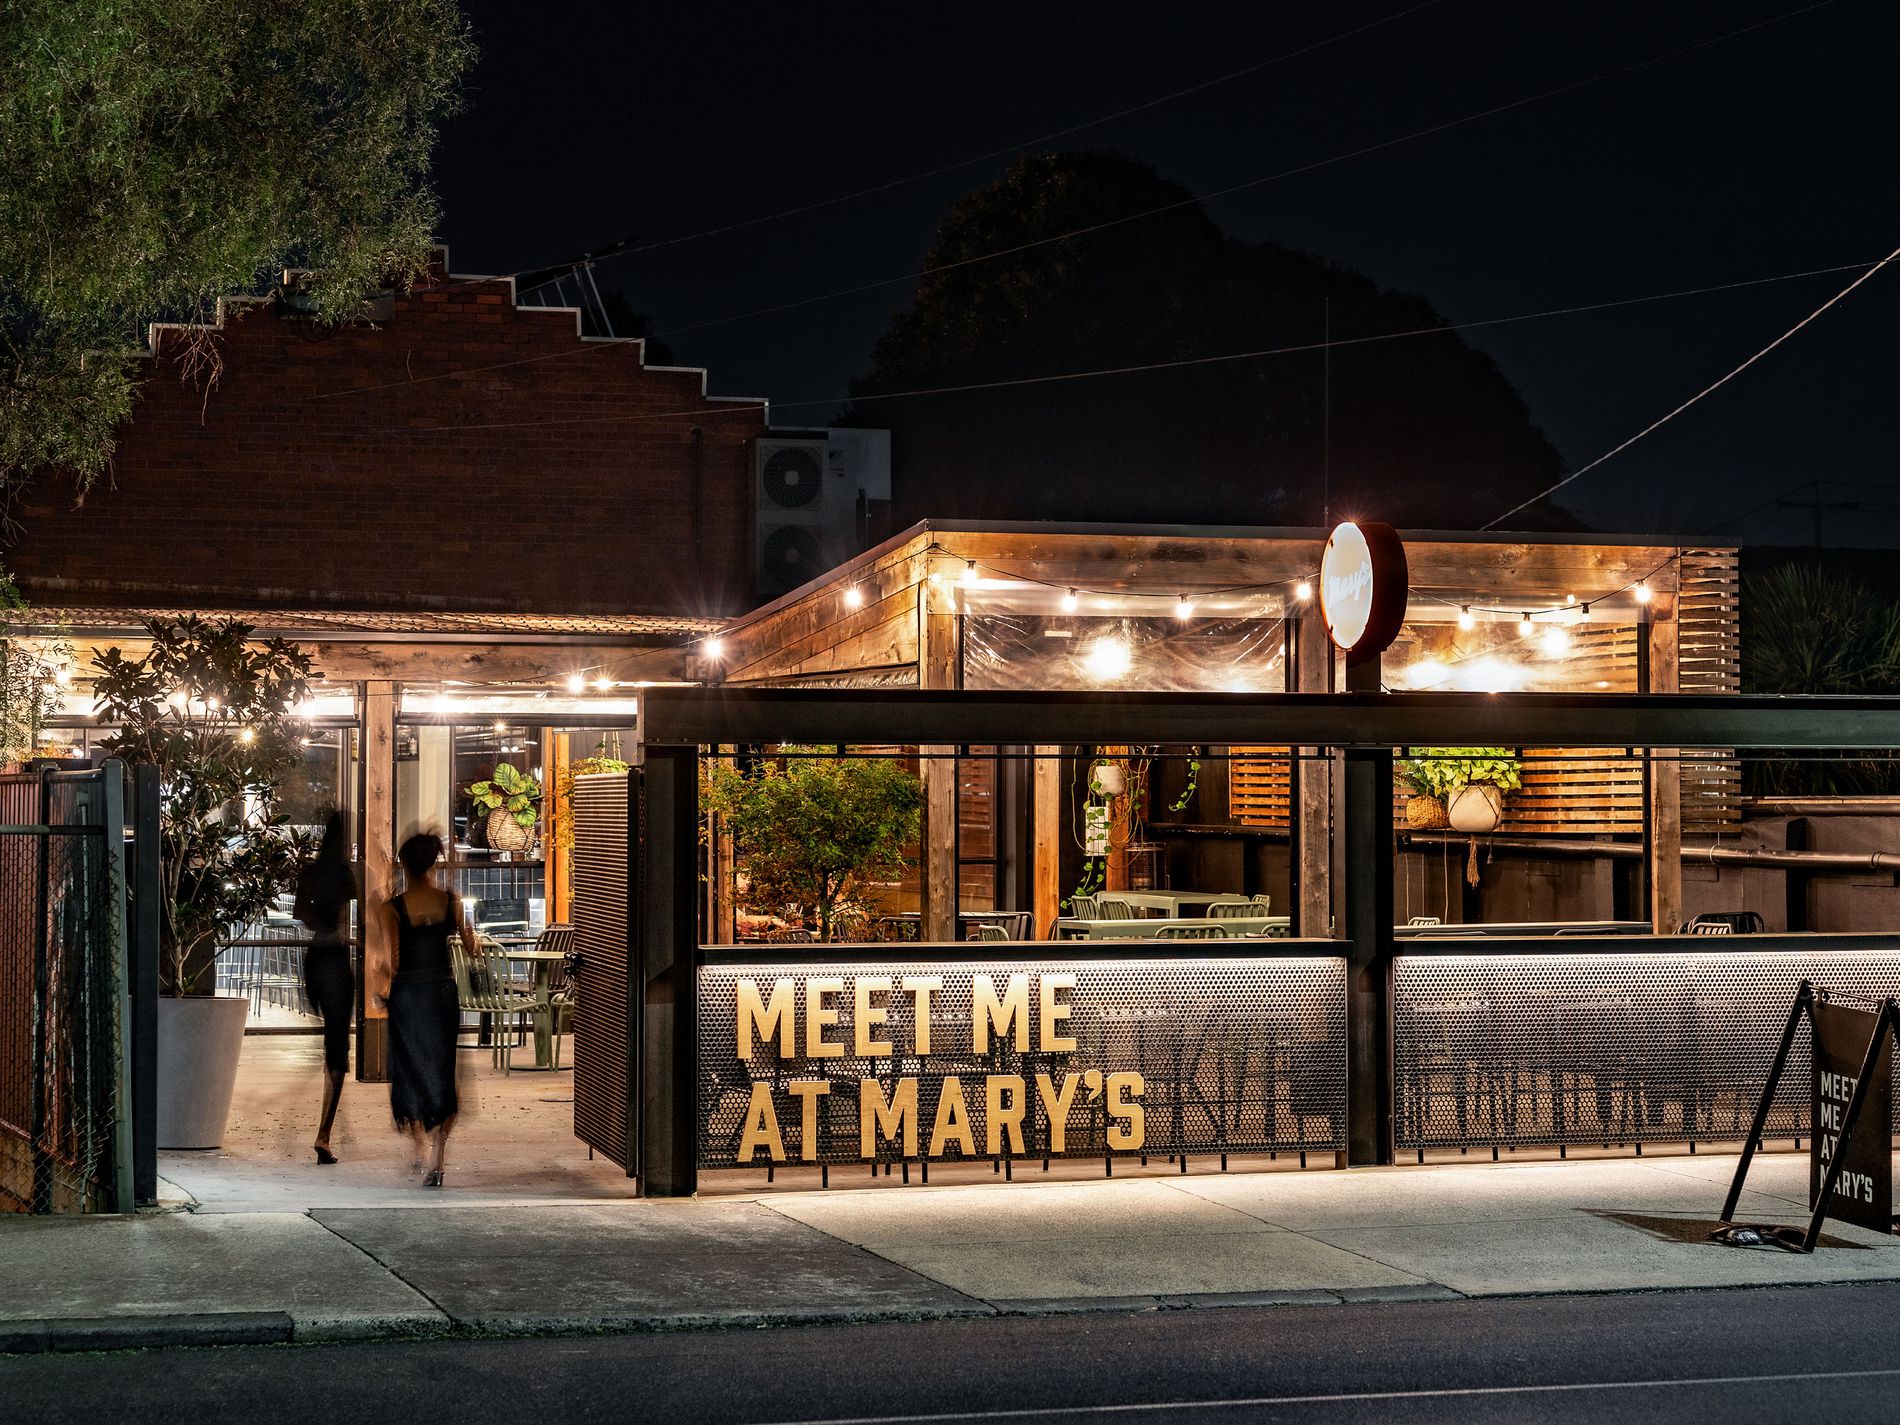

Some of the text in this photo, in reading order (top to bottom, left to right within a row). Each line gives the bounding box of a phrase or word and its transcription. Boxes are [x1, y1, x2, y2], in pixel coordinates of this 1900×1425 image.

[737, 973, 1077, 1060] MEET ME
[1821, 1070, 1859, 1102] MEET
[737, 1069, 1145, 1163] AT MARY'S
[1821, 1102, 1841, 1131] ME
[1821, 1134, 1838, 1160] AT
